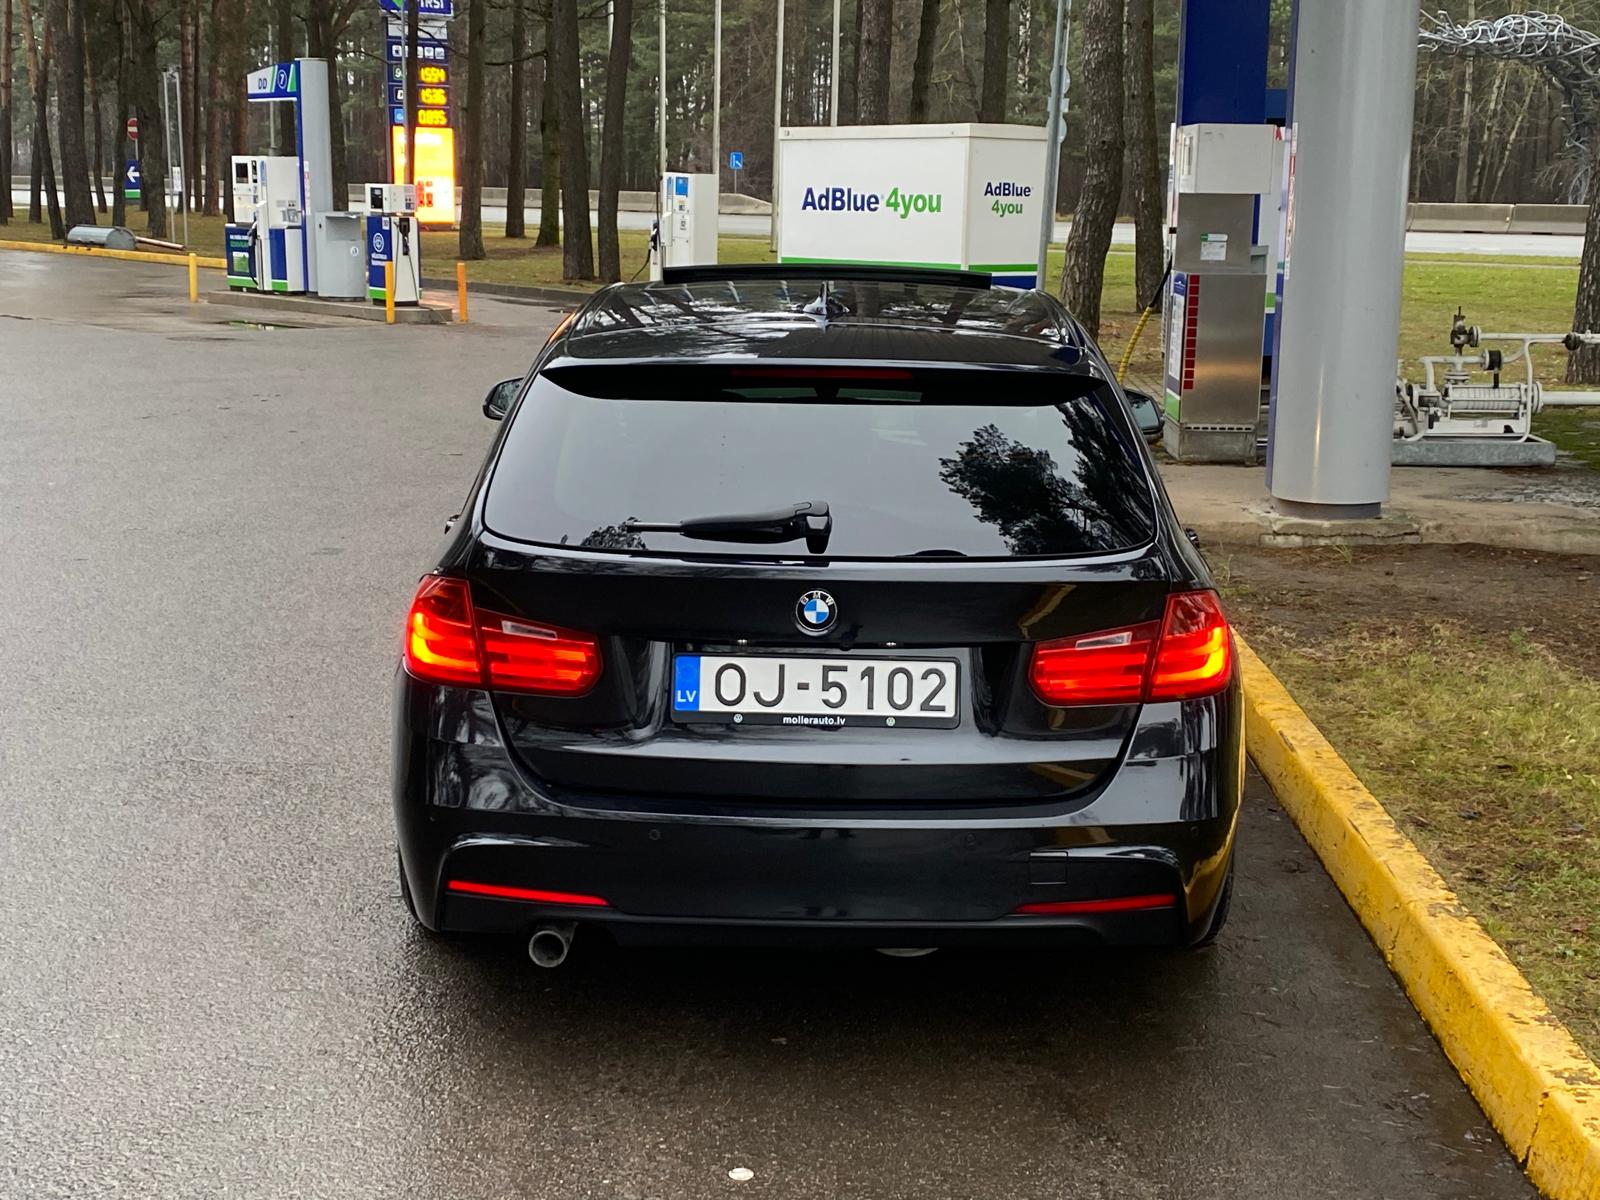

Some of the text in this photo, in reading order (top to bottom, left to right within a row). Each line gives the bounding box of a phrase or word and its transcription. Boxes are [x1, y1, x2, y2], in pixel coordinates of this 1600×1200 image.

[280, 73, 285, 85] 7
[984, 181, 1031, 197] AdBlue
[802, 187, 942, 219] AdBlue 4you
[991, 199, 1023, 218] 4you
[800, 591, 834, 606] BMW
[714, 662, 947, 712] OJ-5102
[677, 690, 696, 703] LV
[783, 715, 846, 725] mollerauto.lv
